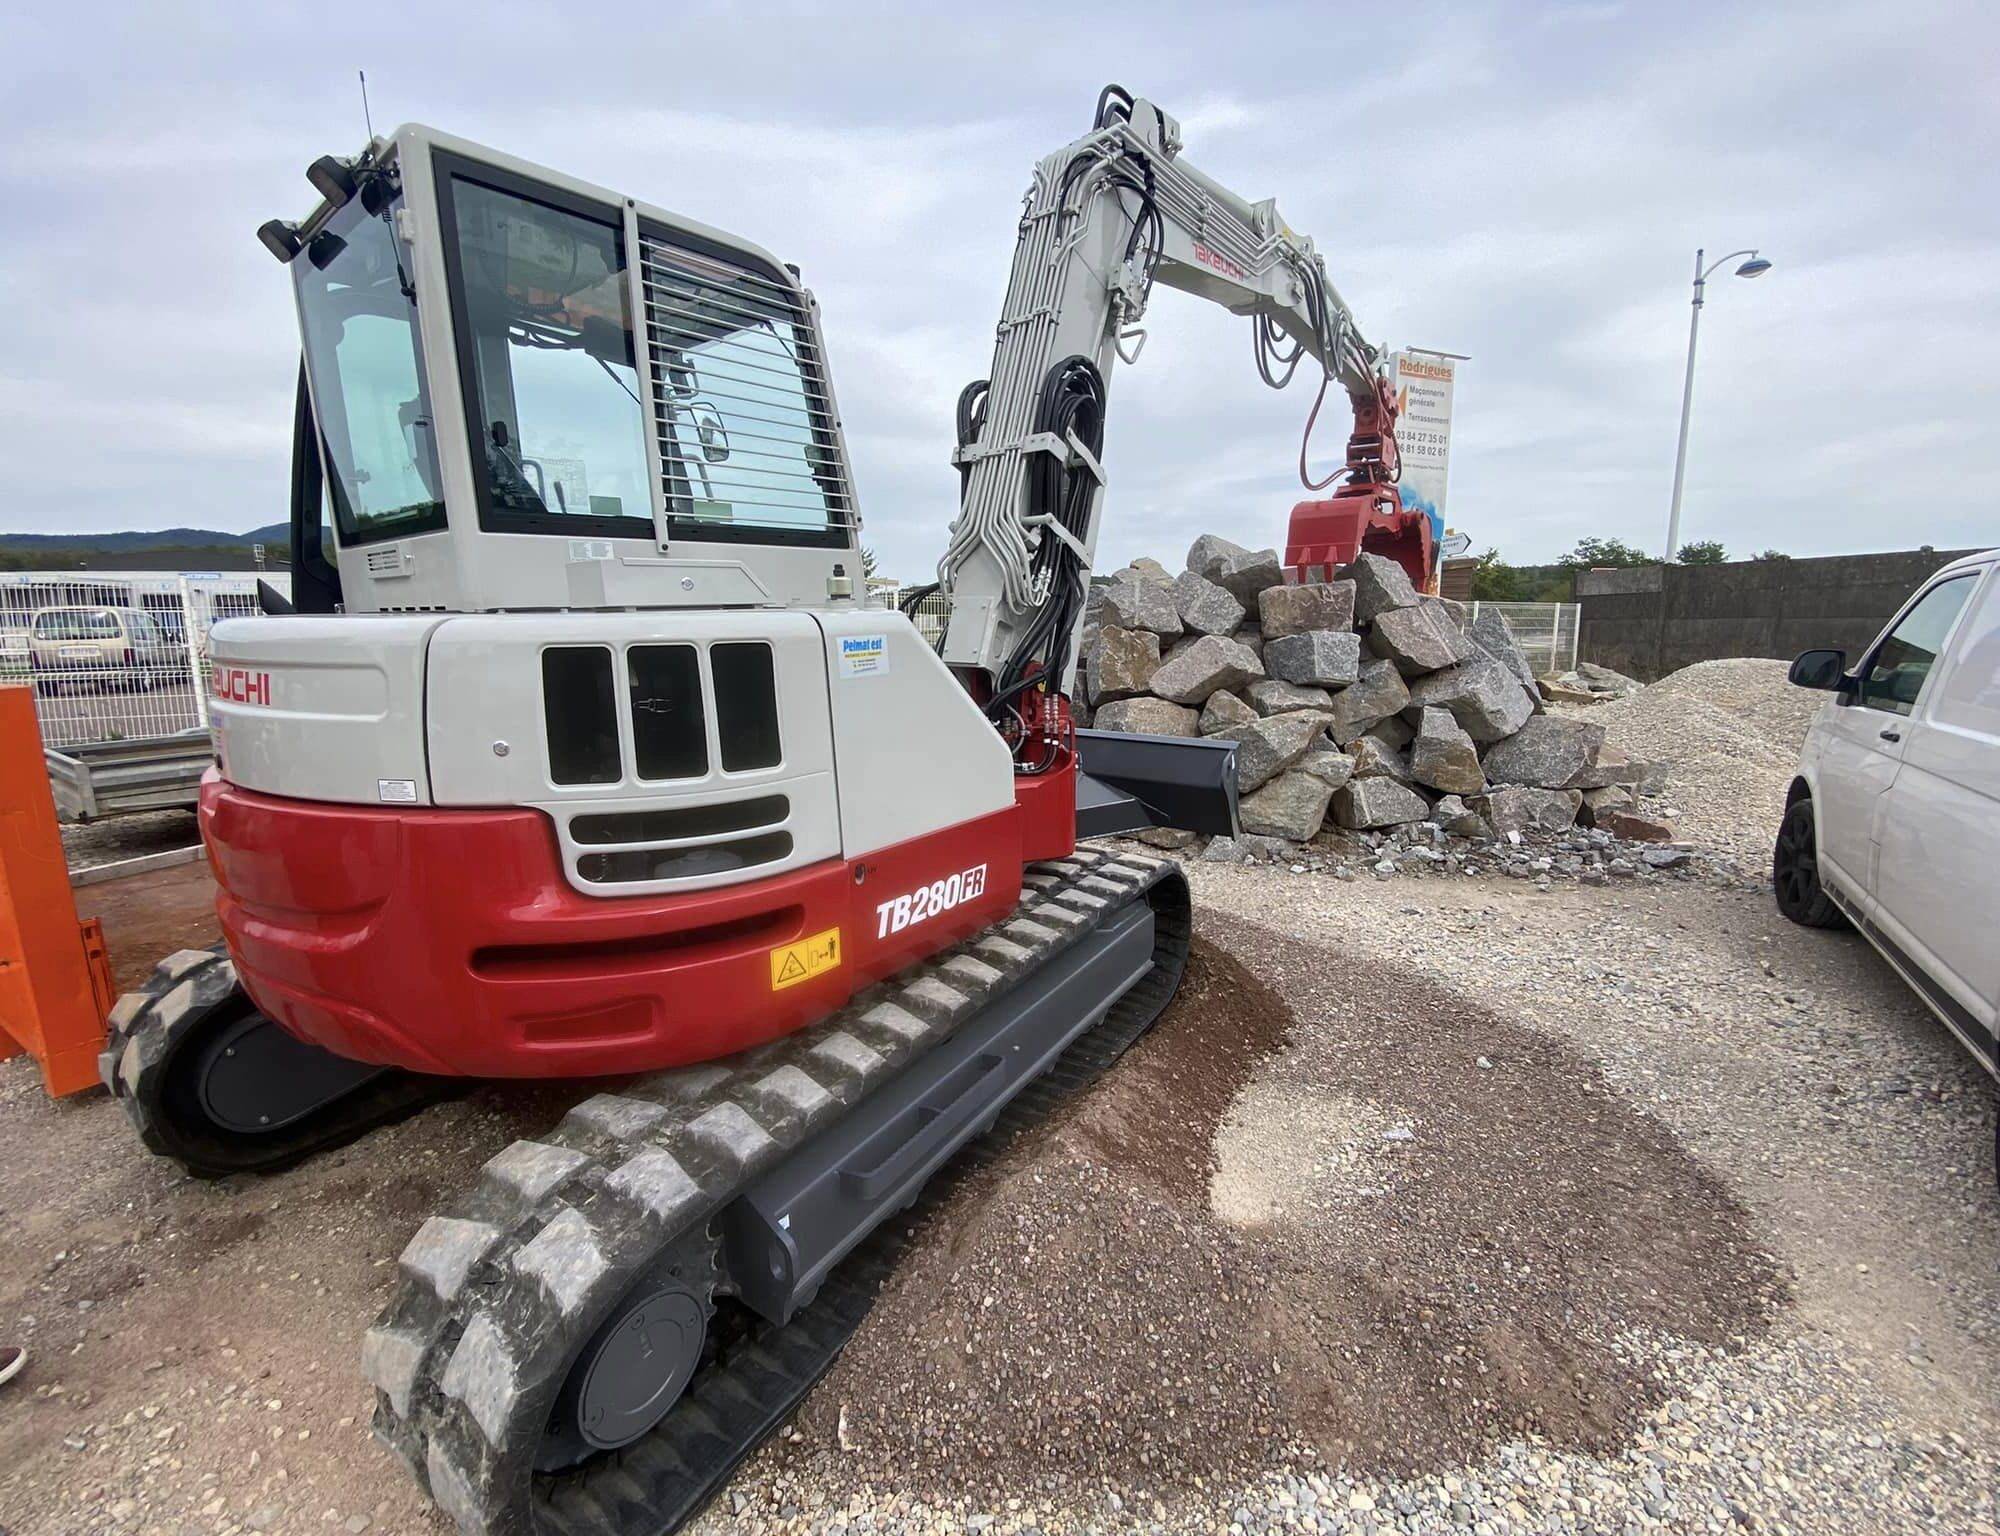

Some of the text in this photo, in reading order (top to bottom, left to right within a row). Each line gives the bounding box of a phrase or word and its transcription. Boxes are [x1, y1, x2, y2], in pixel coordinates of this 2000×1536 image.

[1192, 243, 1244, 281] TAKEUCHI
[1400, 359, 1452, 378] Rodrigues
[1409, 385, 1445, 397] Maçonnerie
[1409, 398, 1435, 408] générale
[1408, 413, 1449, 424] Terrassement
[1396, 430, 1447, 445] 03 84 27 35 01
[1406, 444, 1415, 454] 81
[1427, 446, 1437, 456] 02
[1438, 447, 1446, 457] 61
[871, 638, 882, 650] est
[876, 863, 987, 939] TB280FR
